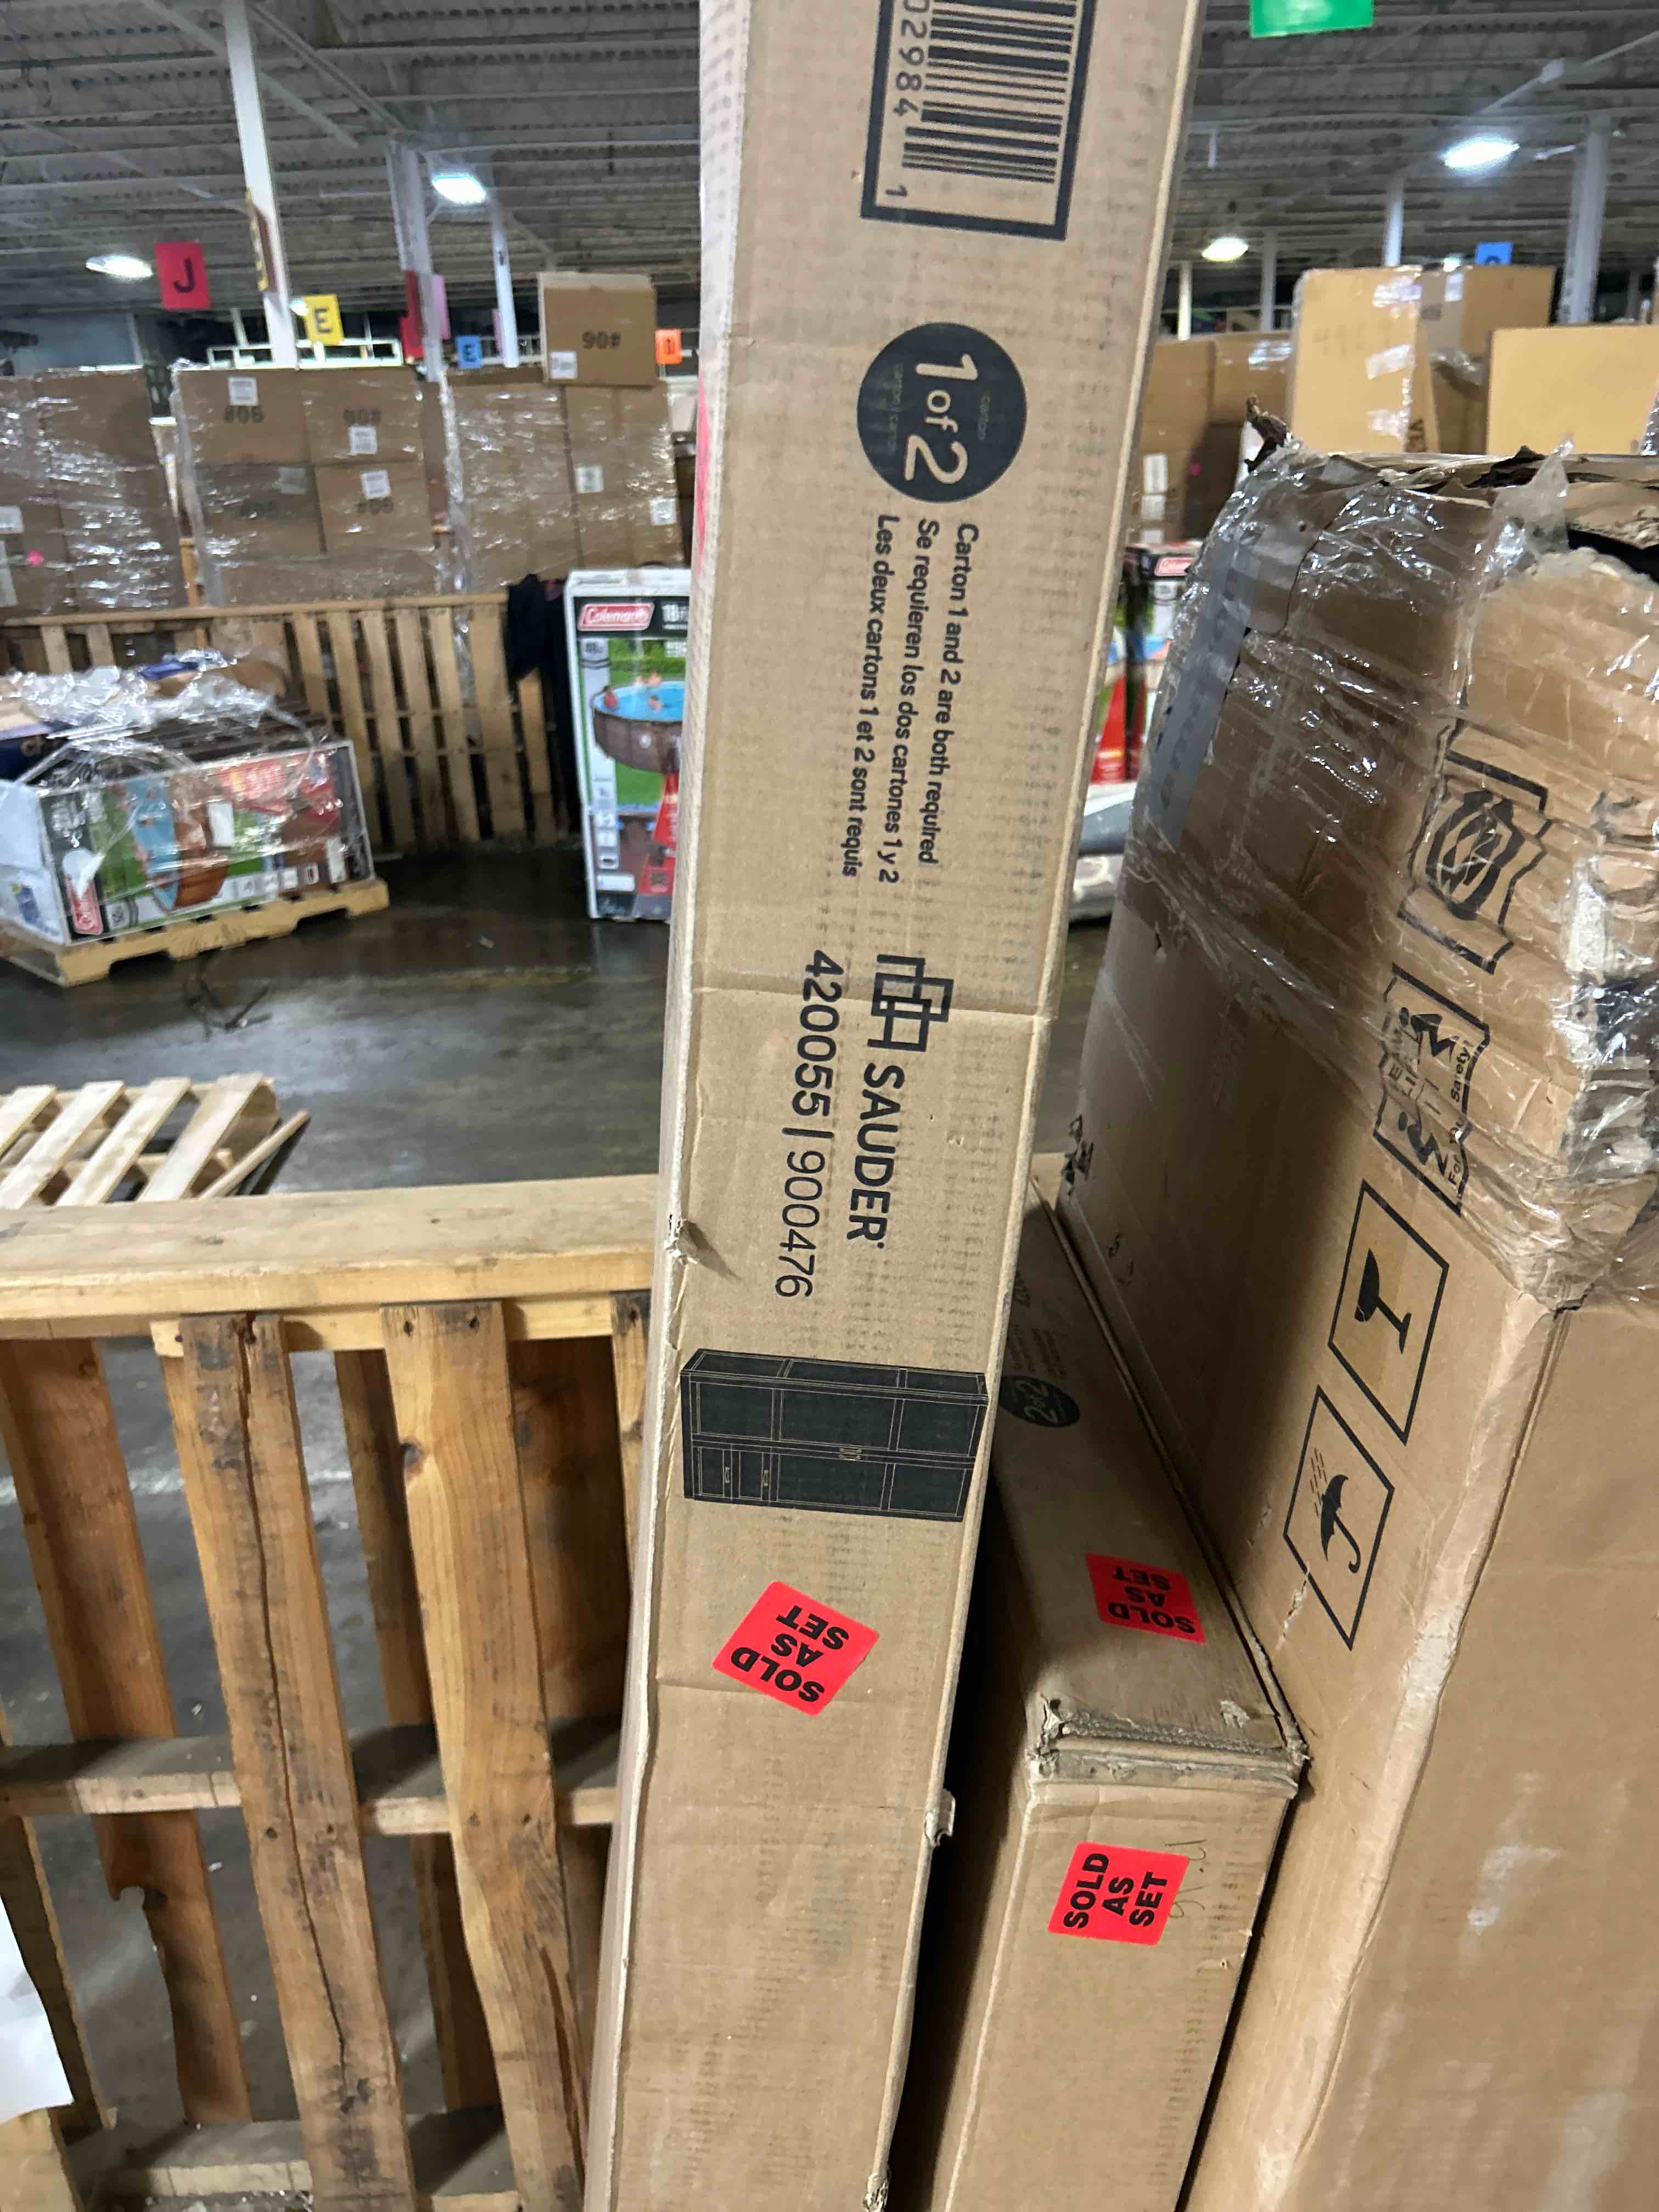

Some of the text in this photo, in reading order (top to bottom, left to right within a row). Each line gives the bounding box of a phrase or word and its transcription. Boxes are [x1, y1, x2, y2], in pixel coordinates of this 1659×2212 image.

[884, 184, 908, 198] 1
[173, 257, 195, 294] J
[313, 307, 332, 334] E
[463, 343, 476, 362] E
[904, 352, 979, 484] 1 of 2
[840, 514, 900, 878] Les deux cartons 1 et 2 sont requis
[877, 518, 940, 884] Se requieren los dos cartones 1 y 2
[918, 522, 979, 865] Carton 1 and 2 are both required
[792, 949, 844, 1118] 420055
[846, 1062, 905, 1242] SAUDER
[1448, 1155, 1461, 1186] For
[774, 1149, 826, 1298] 900476
[1111, 1565, 1172, 1591] SET
[1124, 1585, 1167, 1608] AS
[775, 1605, 850, 1650] SET
[1107, 1601, 1196, 1634] SOLD
[771, 1633, 824, 1668] AS
[731, 1646, 825, 1702] SOLD
[1063, 1853, 1110, 1929] SOLD
[1102, 1876, 1135, 1917] AS
[1128, 1871, 1168, 1927] SET
